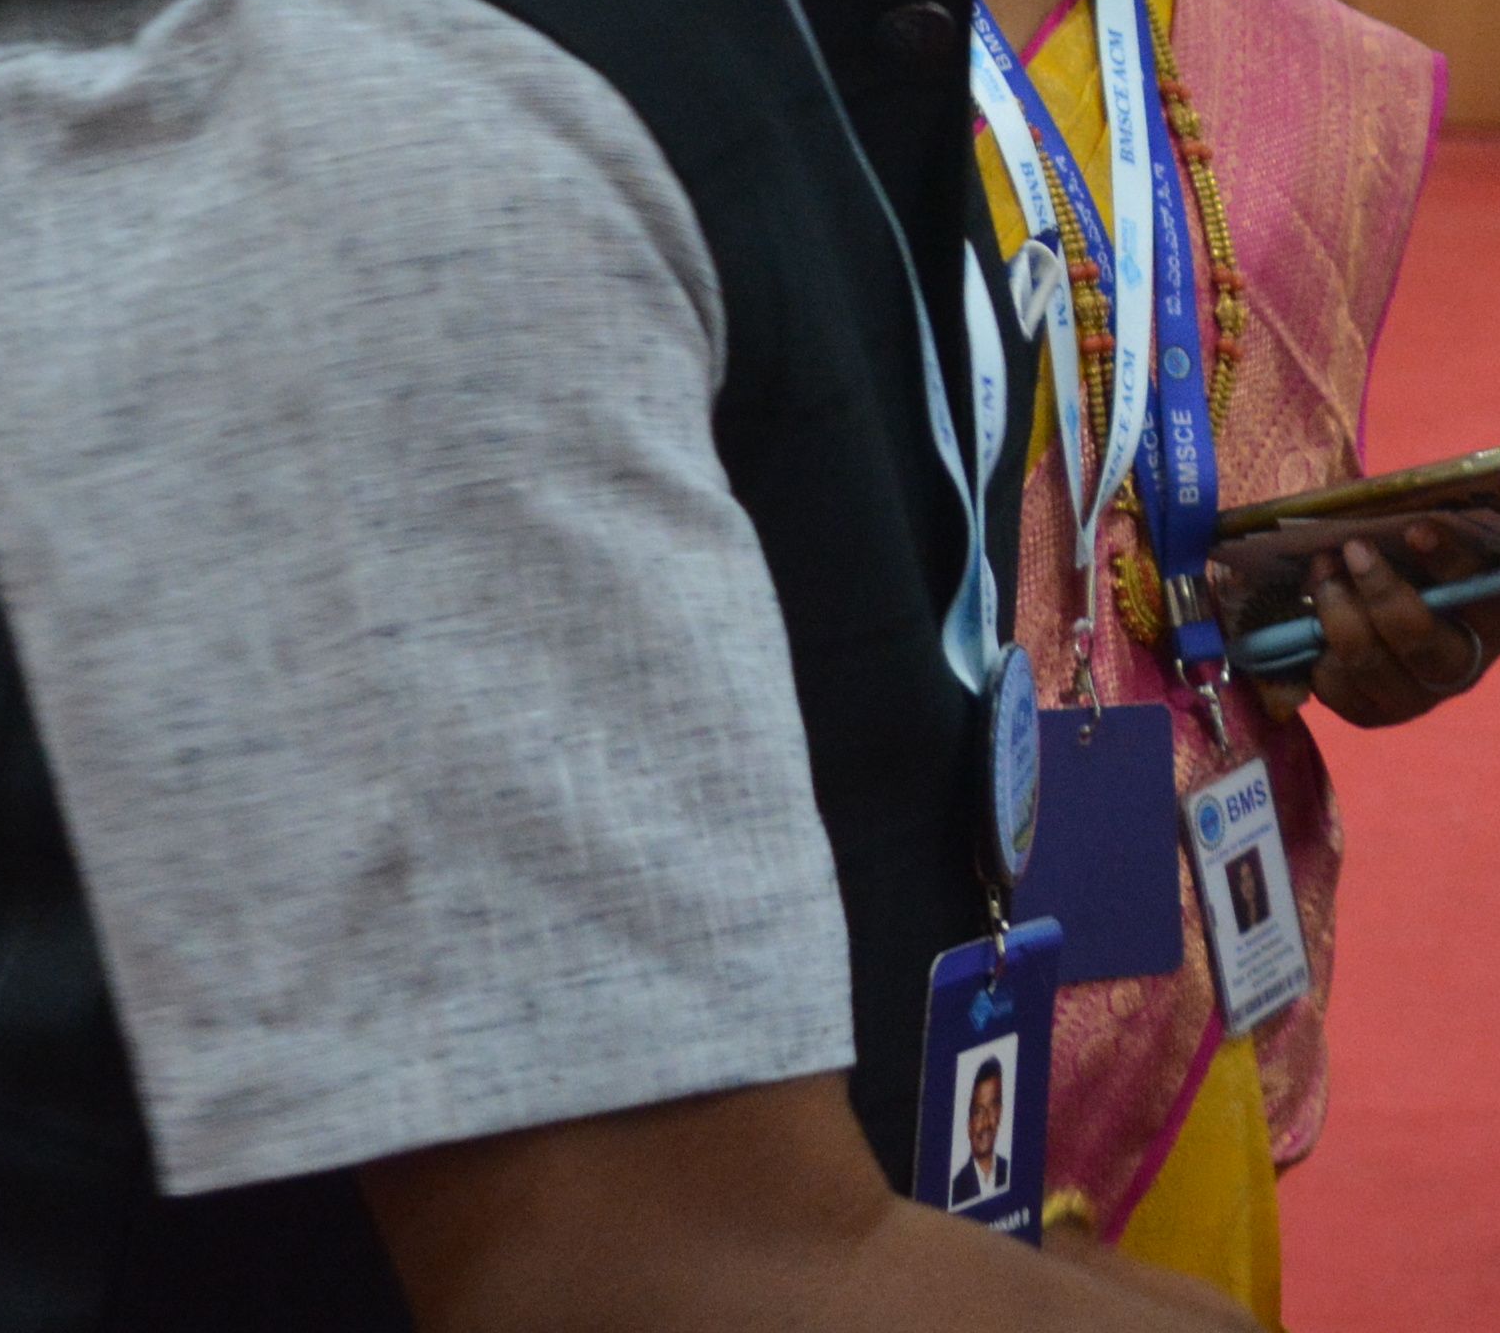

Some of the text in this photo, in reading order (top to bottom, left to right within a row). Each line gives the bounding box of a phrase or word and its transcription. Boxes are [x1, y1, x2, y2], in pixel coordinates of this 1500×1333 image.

[971, 1, 1013, 73] BMSC
[1105, 29, 1136, 166] BMSCE ACM
[1019, 161, 1052, 232] BMSC
[1120, 346, 1136, 410] ACM
[1171, 408, 1200, 505] BMSCE
[1226, 779, 1267, 823] BMS
